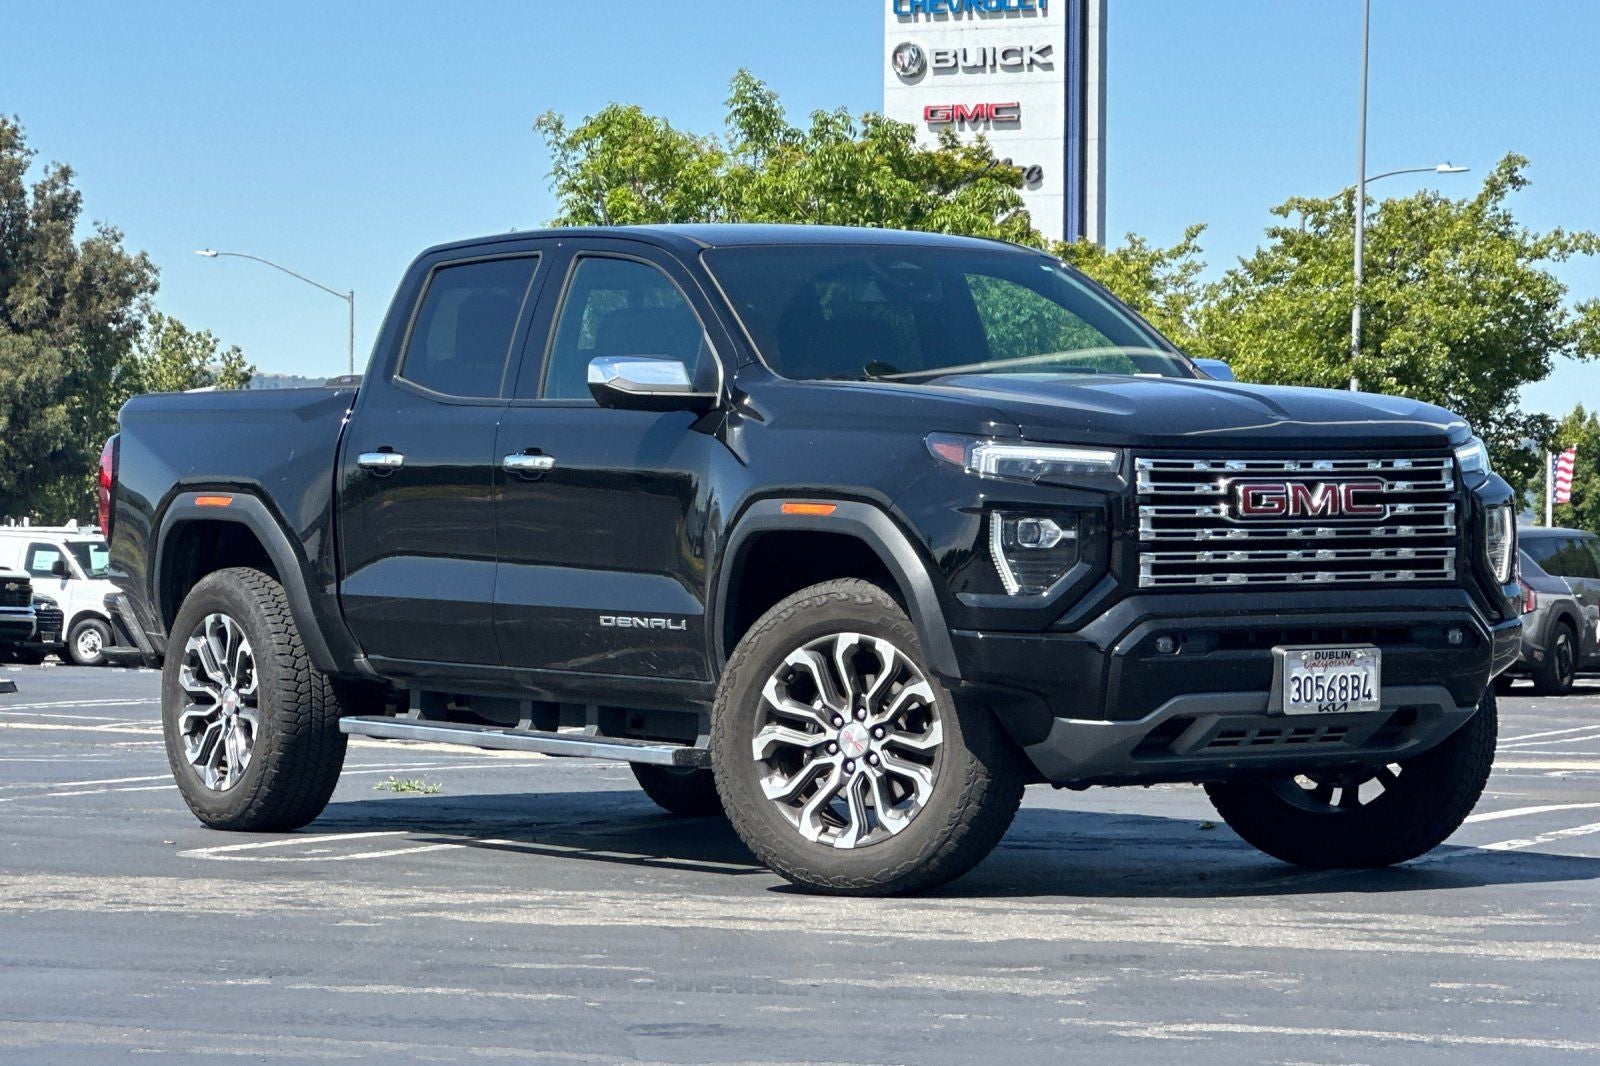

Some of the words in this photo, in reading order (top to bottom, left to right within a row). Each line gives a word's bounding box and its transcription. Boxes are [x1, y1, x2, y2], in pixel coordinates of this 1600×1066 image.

[931, 45, 1053, 68] BUICK
[923, 102, 1019, 122] GMC
[1236, 482, 1384, 517] GMC
[599, 615, 687, 631] DENALI
[1314, 651, 1351, 660] DUBLIN
[1290, 674, 1372, 702] 30568B4
[1318, 702, 1348, 712] KIA
